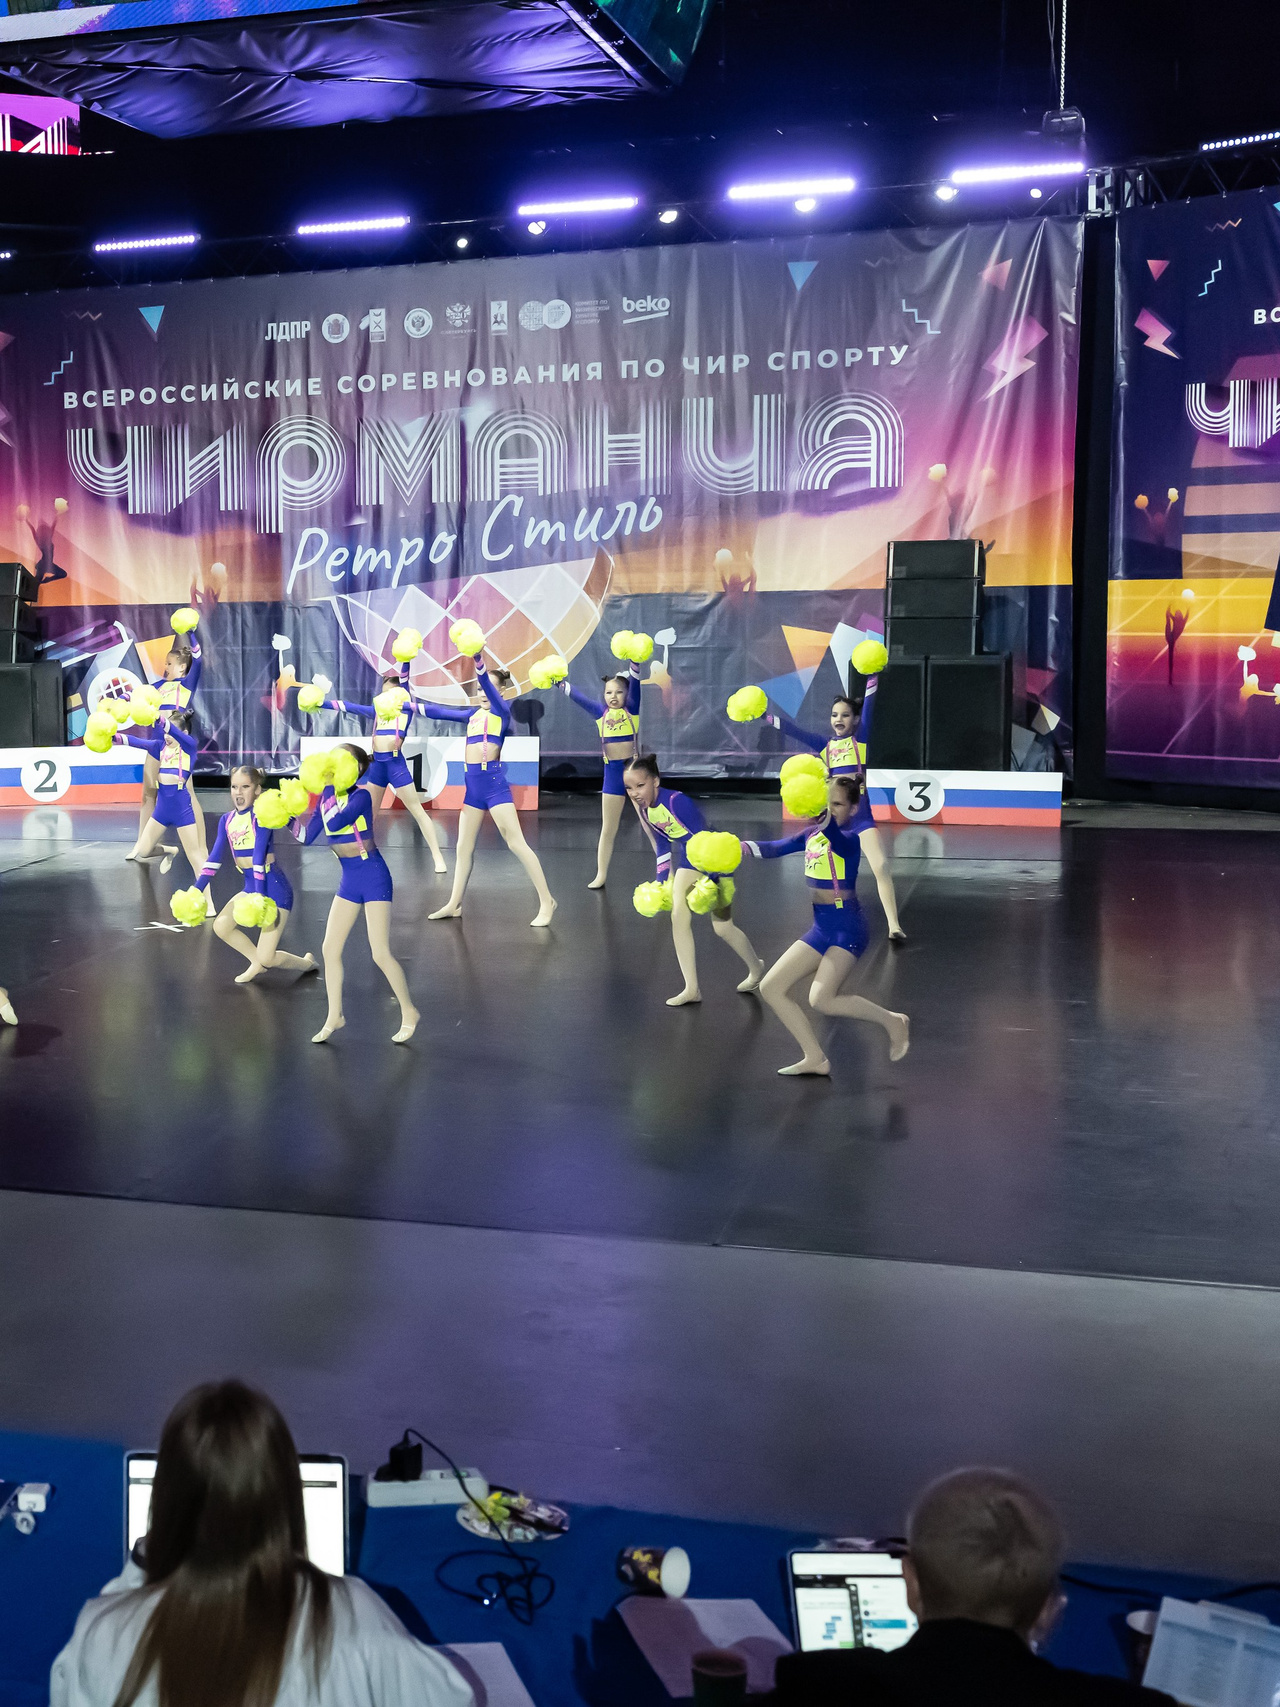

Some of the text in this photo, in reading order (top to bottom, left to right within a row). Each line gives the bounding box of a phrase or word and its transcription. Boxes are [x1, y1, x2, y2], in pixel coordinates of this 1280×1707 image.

[622, 295, 670, 313] beko
[265, 320, 311, 342] ЛДПР
[64, 344, 910, 409] ВСЕРОССИЙСКИЕ СОРЕВНОВАНИЯ ПО ЧИР СПОРТУ
[286, 494, 663, 595] Ретро Стиль
[34, 760, 58, 793] 2
[406, 753, 428, 792] 1
[908, 782, 932, 812] 3
